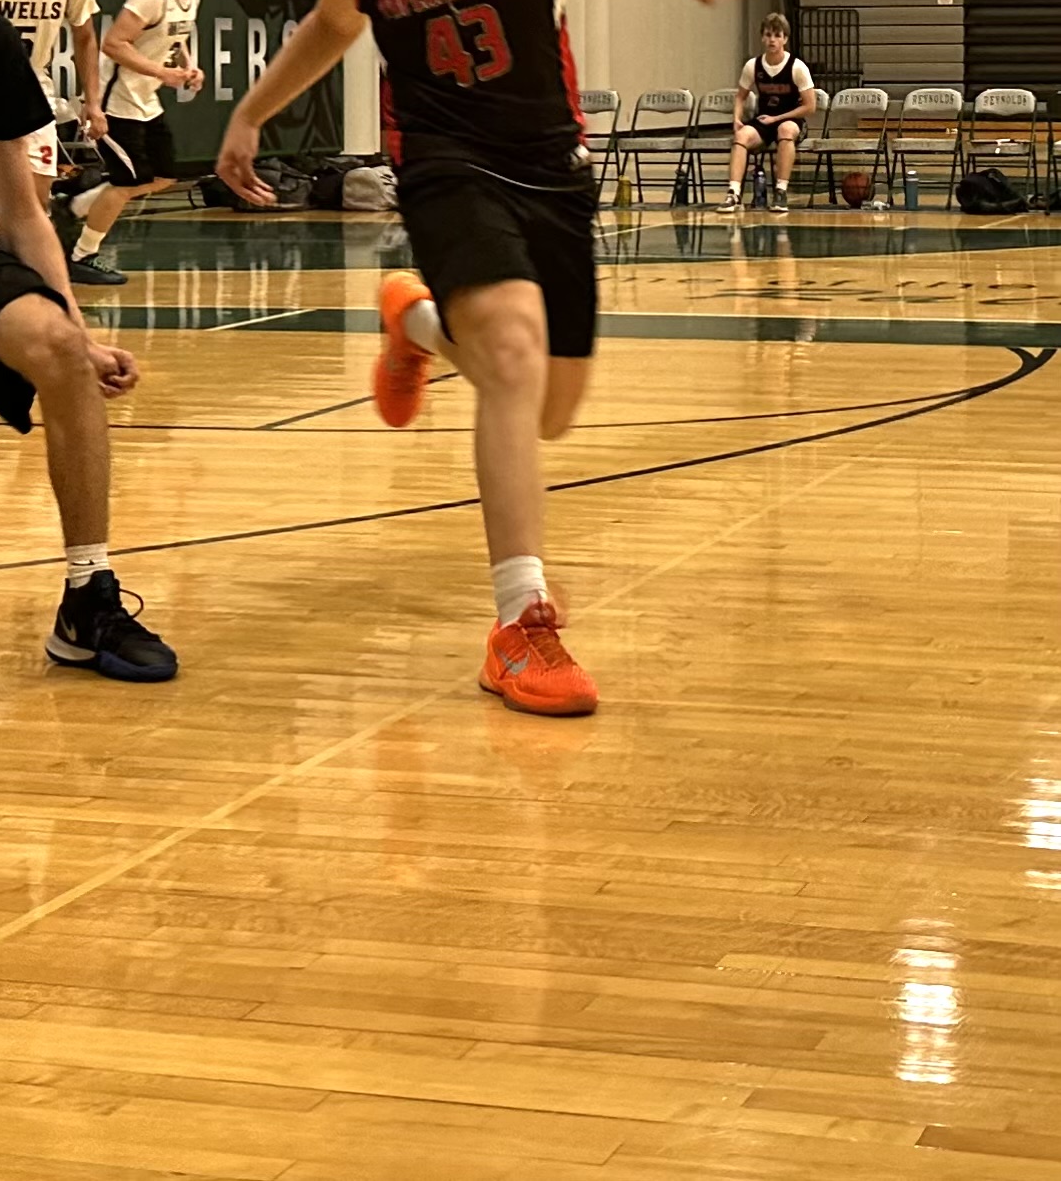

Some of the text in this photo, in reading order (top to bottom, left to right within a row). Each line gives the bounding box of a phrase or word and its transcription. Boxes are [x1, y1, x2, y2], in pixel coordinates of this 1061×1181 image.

[425, 4, 512, 87] 43
[646, 93, 686, 104] REYNOLDS
[838, 94, 881, 105] REYNOLDS
[912, 94, 955, 105] REYNOLDS
[983, 95, 1027, 106] REYNOLDS
[39, 146, 53, 164] 2
